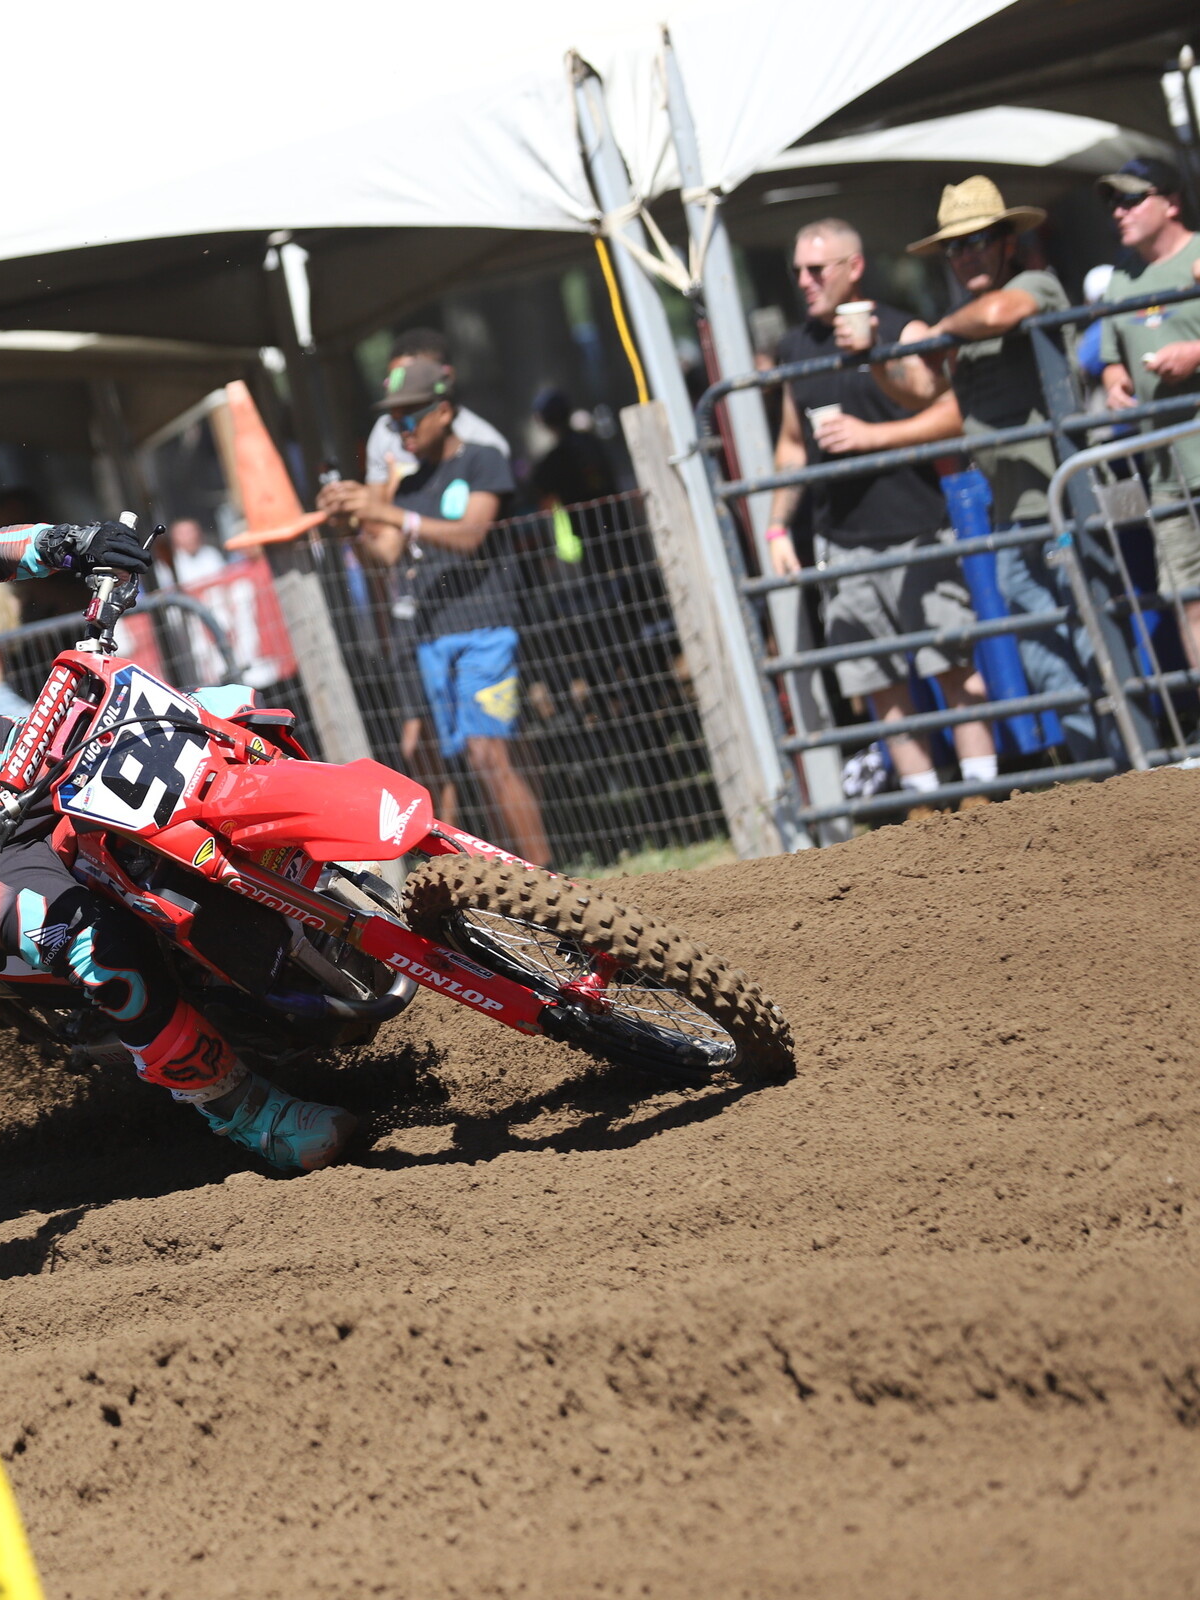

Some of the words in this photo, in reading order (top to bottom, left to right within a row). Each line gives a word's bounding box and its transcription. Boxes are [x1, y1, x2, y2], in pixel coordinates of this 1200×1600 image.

[8, 667, 71, 777] RENTHAL
[22, 677, 78, 784] RENTHAL
[81, 725, 104, 771] LUC
[102, 705, 121, 727] OIL
[101, 691, 210, 830] 94
[184, 762, 208, 798] HONDA
[393, 798, 422, 845] HONDA
[43, 934, 72, 966] HONDA
[386, 952, 504, 1011] DUNLOP
